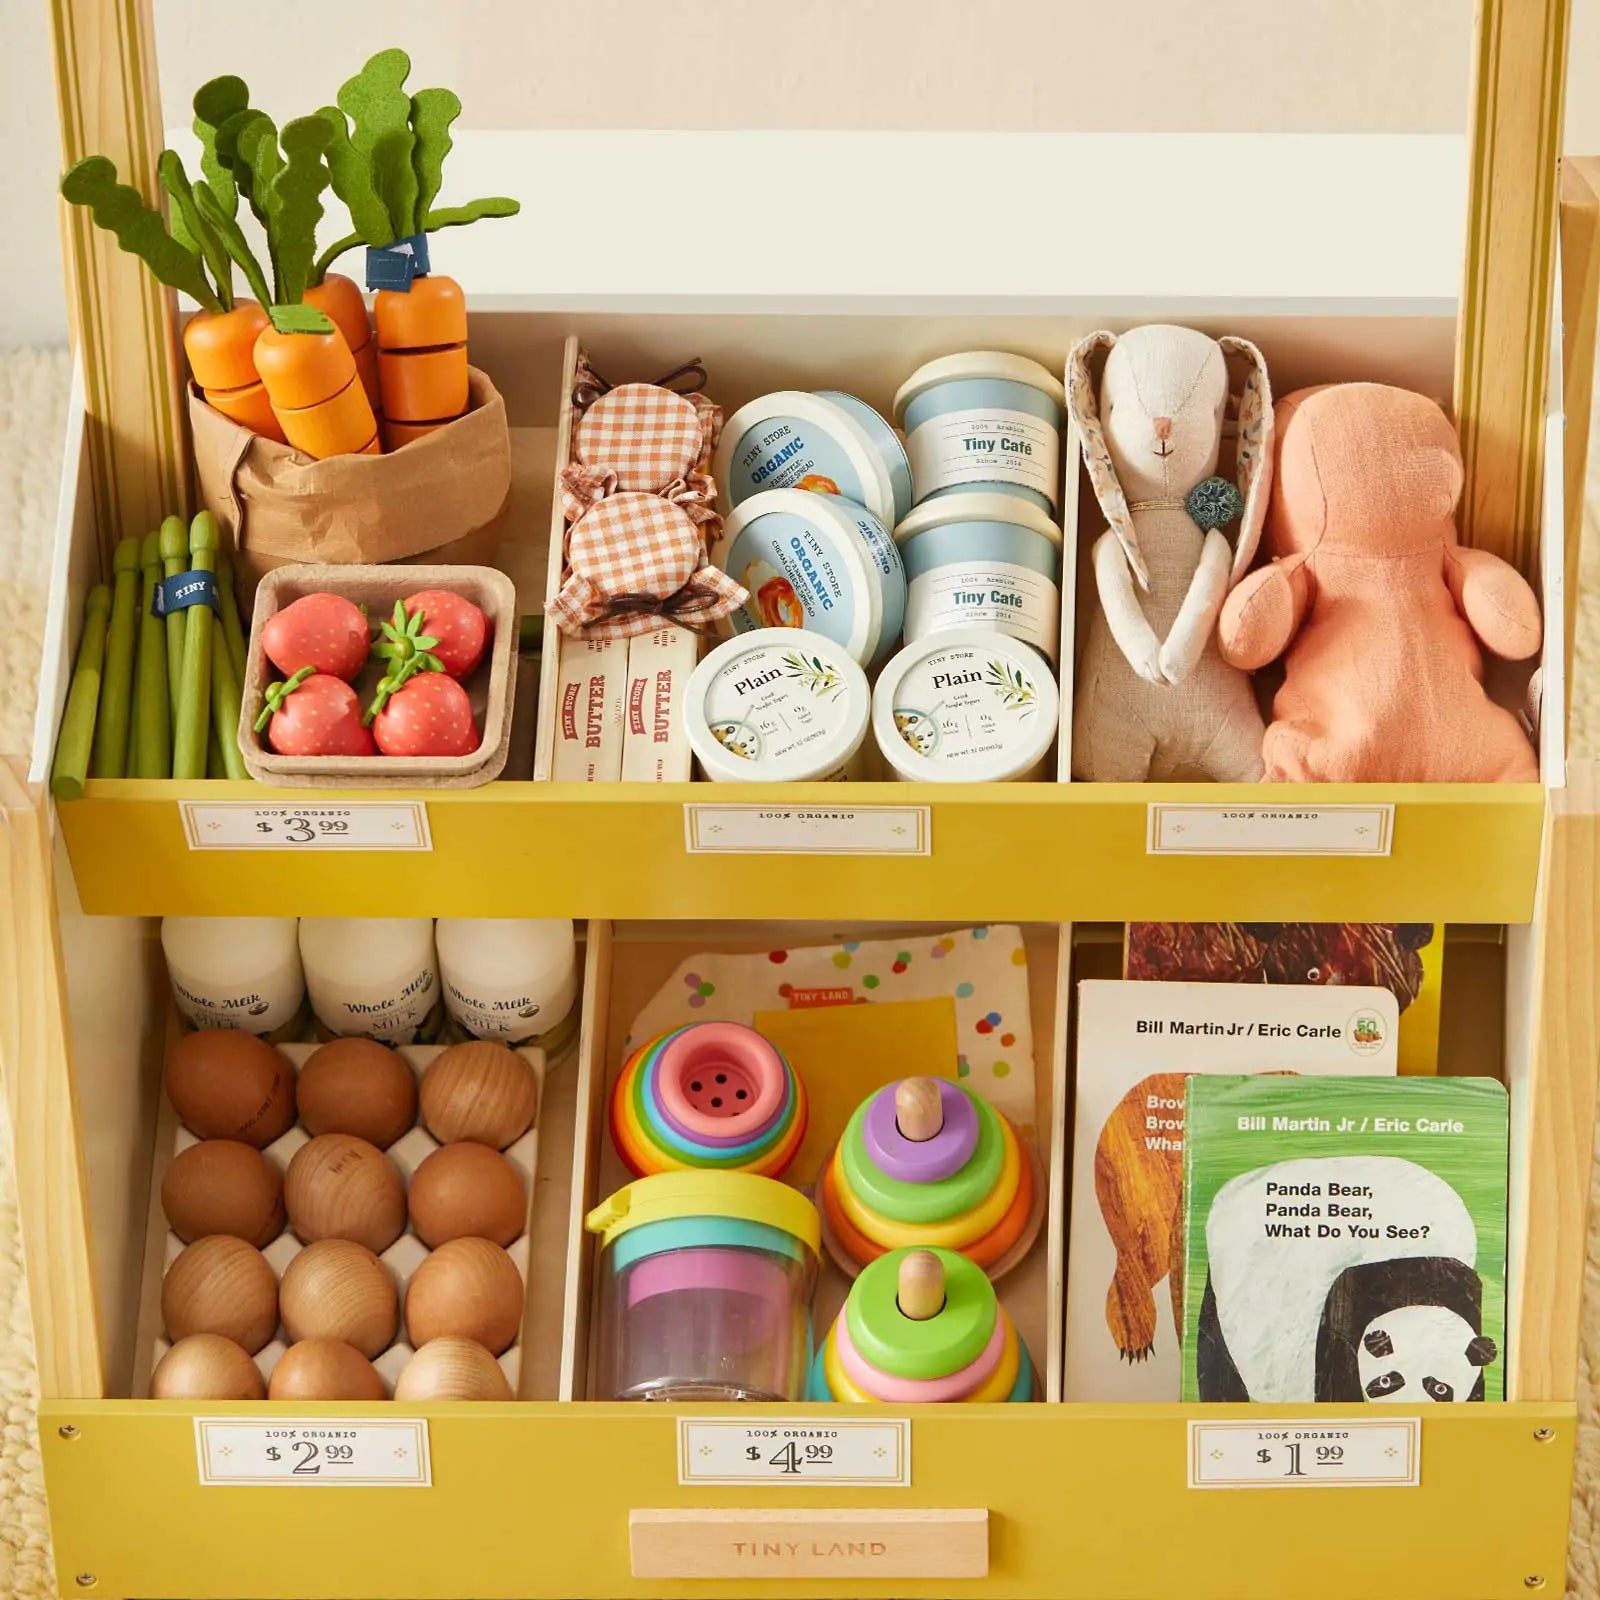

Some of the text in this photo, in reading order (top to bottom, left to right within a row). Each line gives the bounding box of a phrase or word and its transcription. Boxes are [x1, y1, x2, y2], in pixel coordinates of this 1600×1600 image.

[742, 425, 792, 468] TINY STORE
[963, 437, 1032, 456] Tiny Café
[751, 436, 805, 485] ORGANIC
[790, 537, 834, 611] ORGANIC
[803, 530, 842, 599] TINY STORE
[175, 581, 206, 600] TINY
[953, 590, 1023, 608] Tiny Café
[723, 652, 766, 677] TINY STORE
[927, 652, 974, 666] TINY STORE
[734, 668, 784, 697] Plain
[931, 669, 983, 690] Plain
[563, 683, 578, 735] TINY STORE
[585, 674, 606, 749] BUTTER
[630, 677, 645, 731] TINY STORE
[653, 669, 673, 743] BUTTER
[256, 821, 273, 833] $
[284, 817, 316, 842] 3
[176, 981, 216, 1008] Whole
[447, 980, 486, 1010] Whole
[794, 991, 848, 1002] TINY LAND
[342, 998, 396, 1014] Whole
[1136, 1020, 1342, 1038] Bill Martin Jr / Eric Carle
[1237, 1116, 1464, 1133] Bill Martin Jr / Eric Carle
[1145, 1136, 1183, 1151] Wha
[1266, 1182, 1373, 1200] Panda Bear,
[1266, 1203, 1373, 1220] Panda Bear,
[1265, 1223, 1430, 1239] What Do You See?
[265, 1430, 357, 1438] 100% ORGANIC
[747, 1430, 838, 1438] 100% ORGANIC
[1258, 1432, 1349, 1440] 100% ORGANIC
[265, 1446, 281, 1461] $
[292, 1441, 321, 1474] 2
[745, 1446, 761, 1460] $
[769, 1441, 803, 1473] 4
[1257, 1448, 1272, 1464] $
[1284, 1443, 1307, 1476] 1
[733, 1542, 887, 1557] TINY LAND
